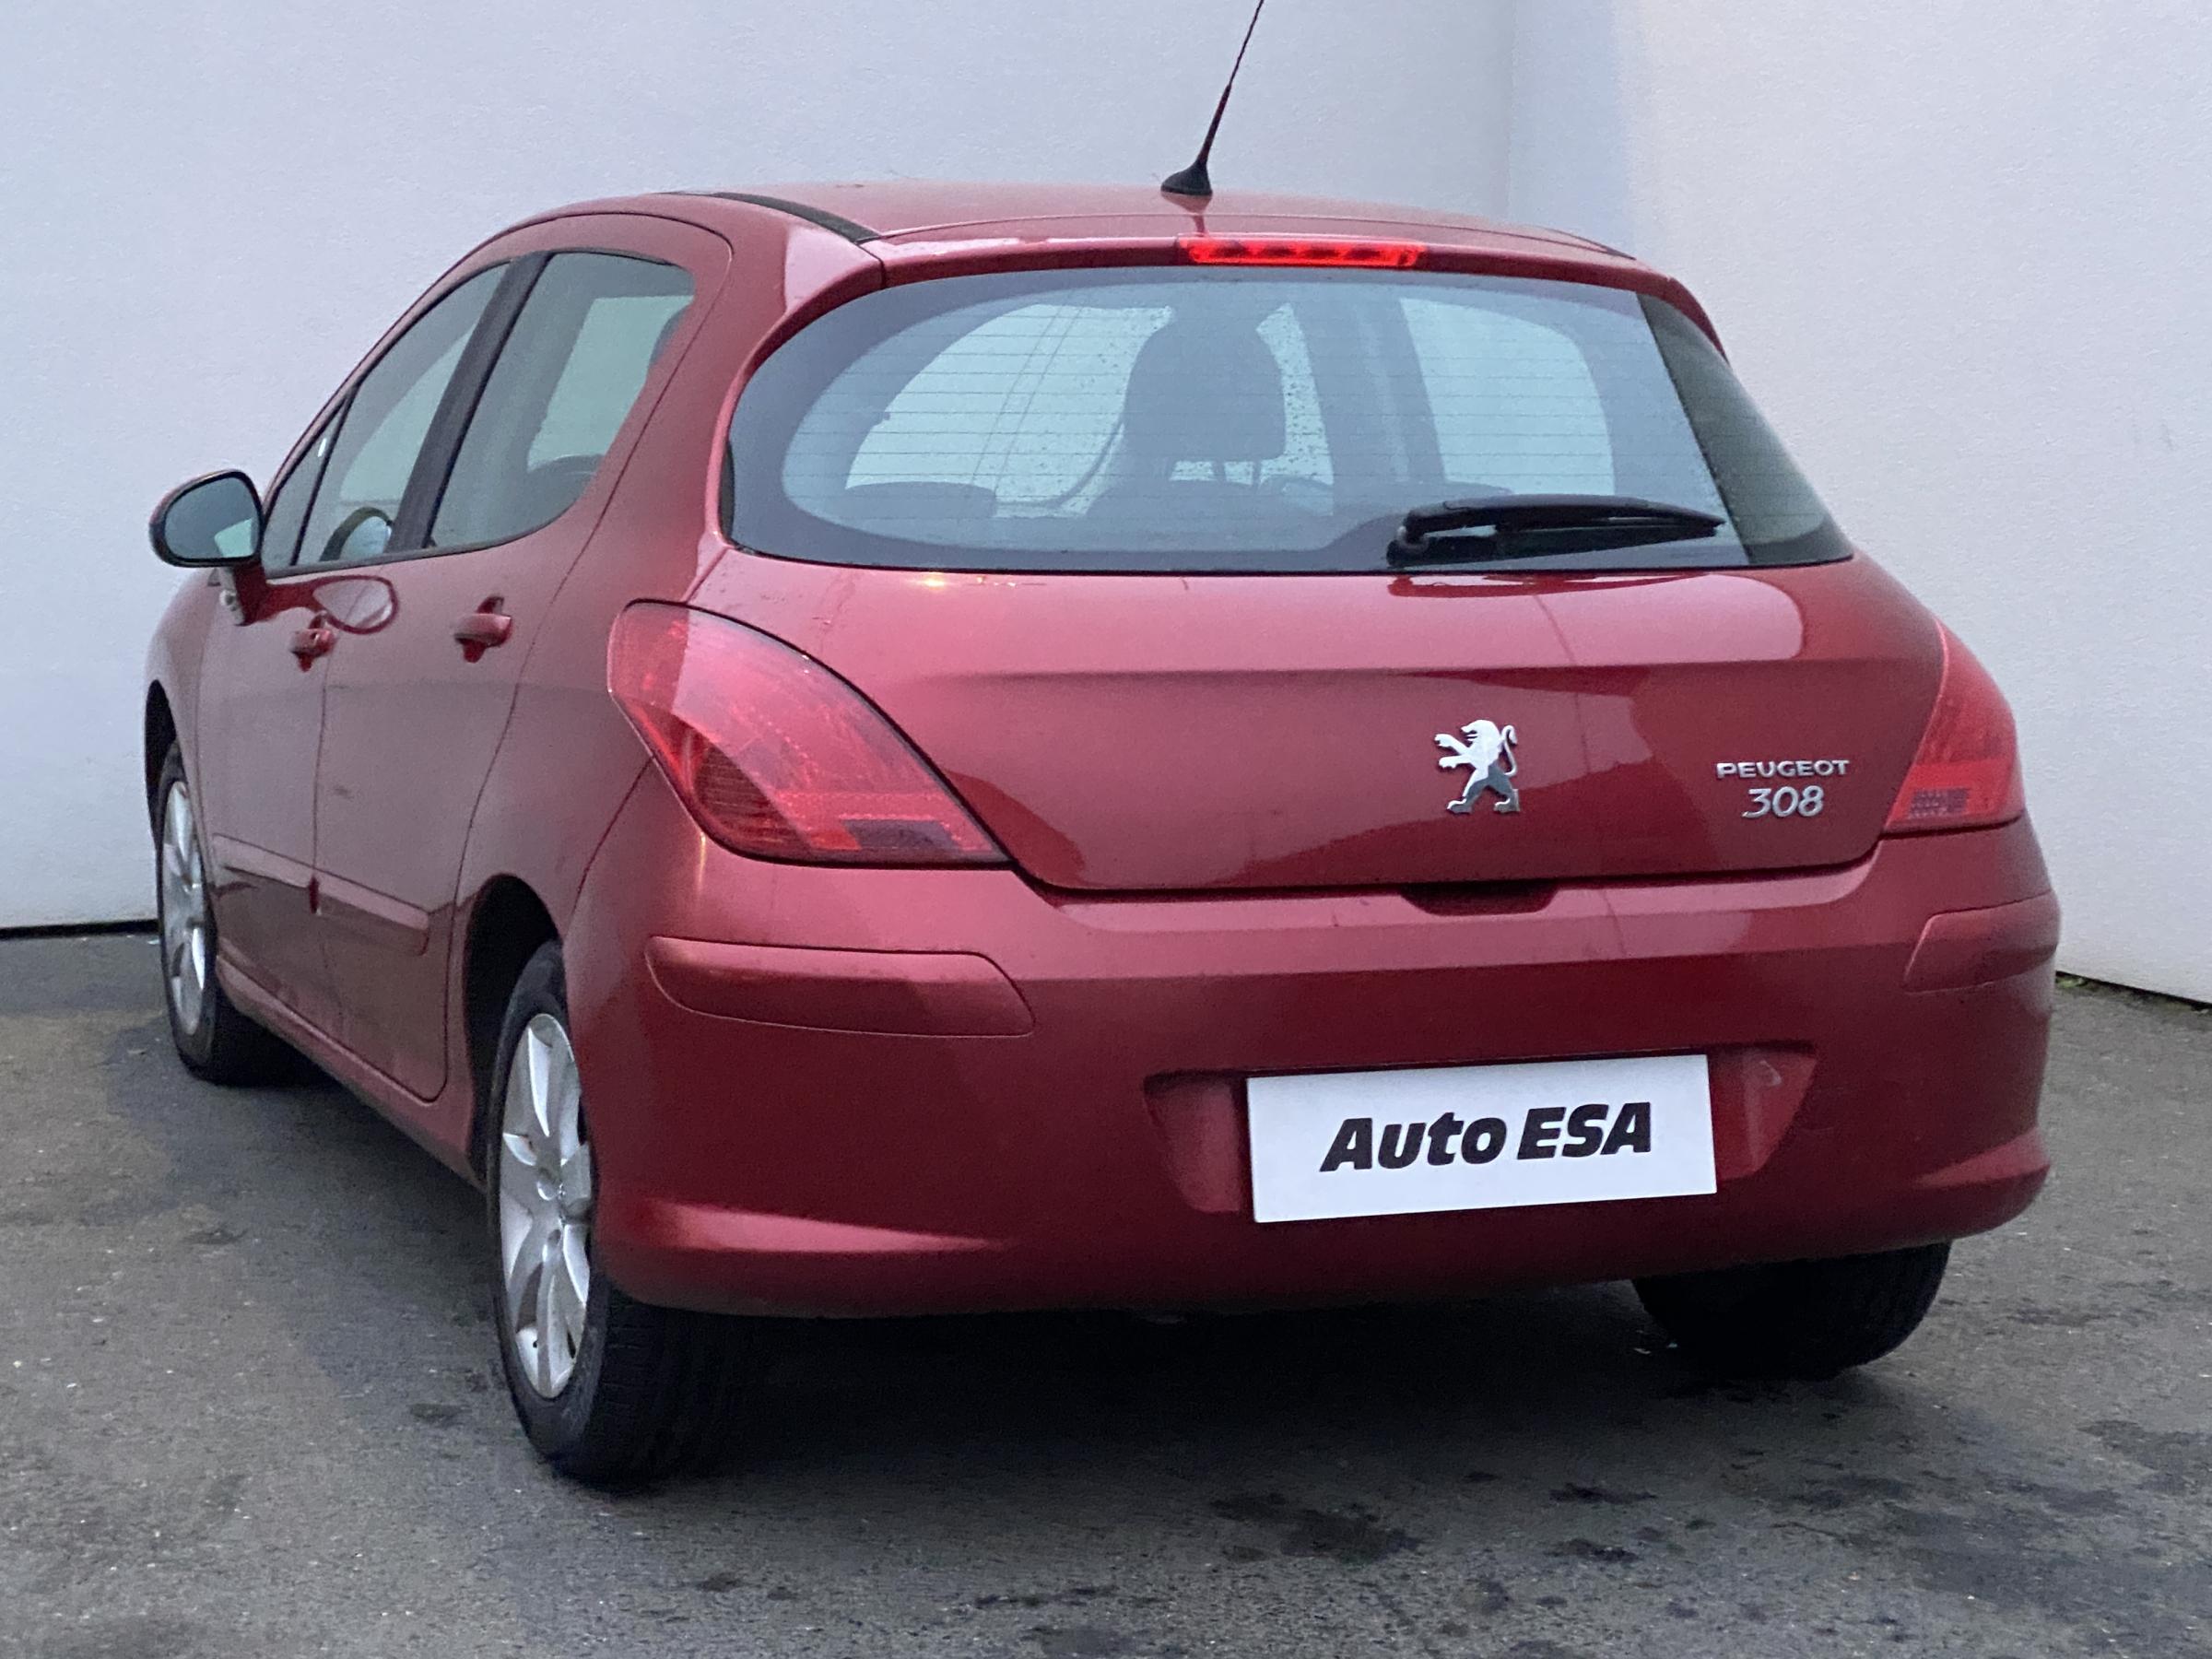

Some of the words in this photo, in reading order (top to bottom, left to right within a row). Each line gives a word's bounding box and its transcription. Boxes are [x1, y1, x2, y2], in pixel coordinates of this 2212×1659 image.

[1715, 759, 1850, 779] PEUGEOT
[1741, 785, 1825, 818] 308
[1319, 1112, 1507, 1172] Auto
[1516, 1101, 1652, 1160] ESA
